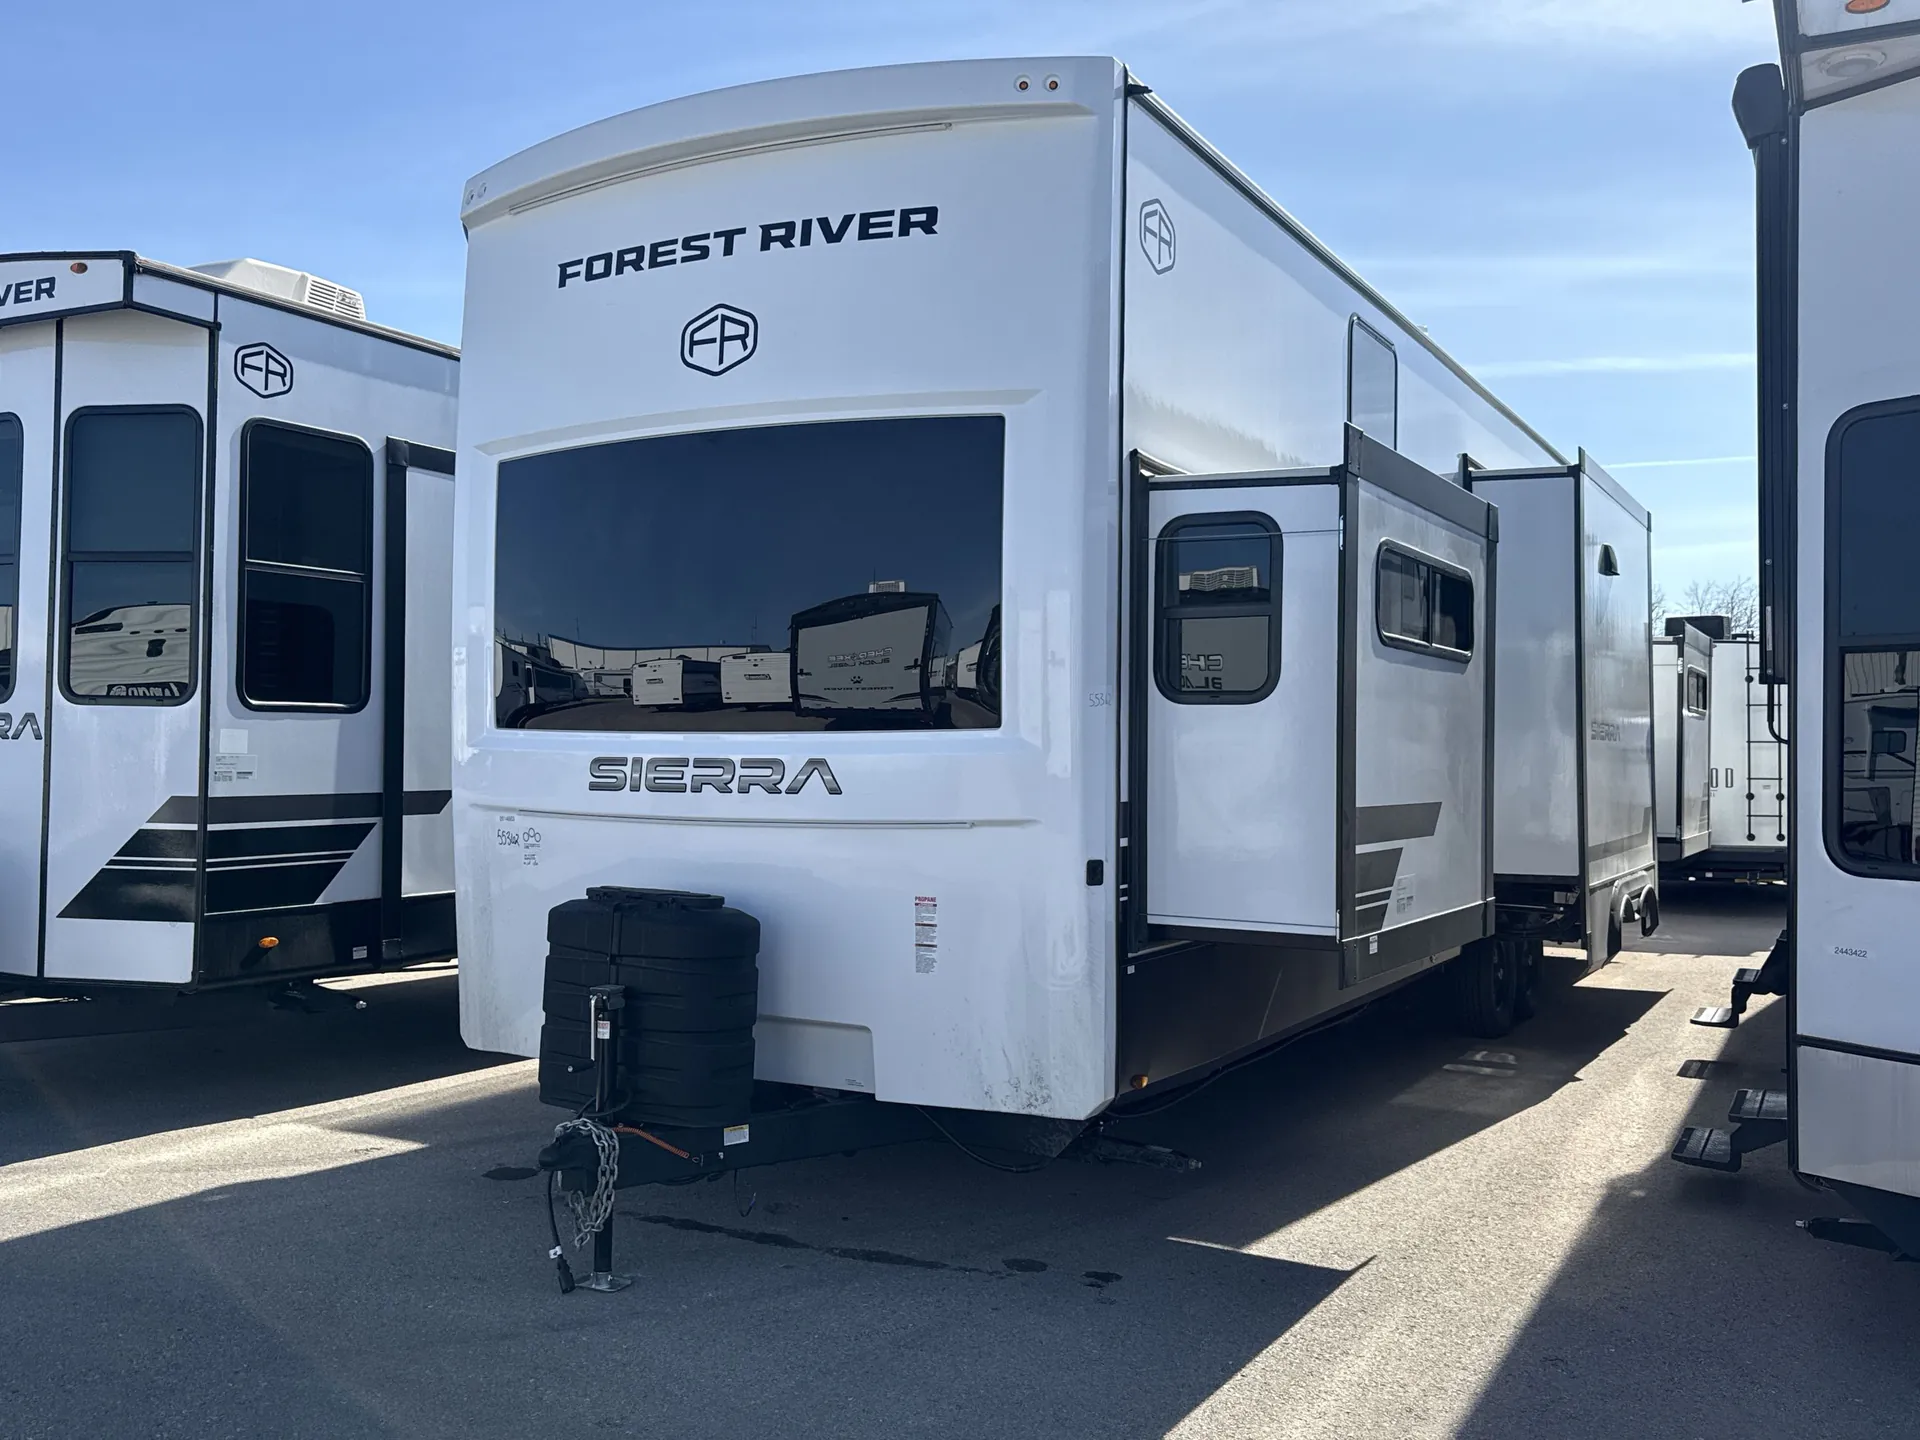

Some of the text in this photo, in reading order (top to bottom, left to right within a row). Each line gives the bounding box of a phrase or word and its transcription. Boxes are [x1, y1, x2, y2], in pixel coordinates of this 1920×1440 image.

[557, 205, 940, 289] FOREST RIVER
[588, 756, 843, 796] SIERRA
